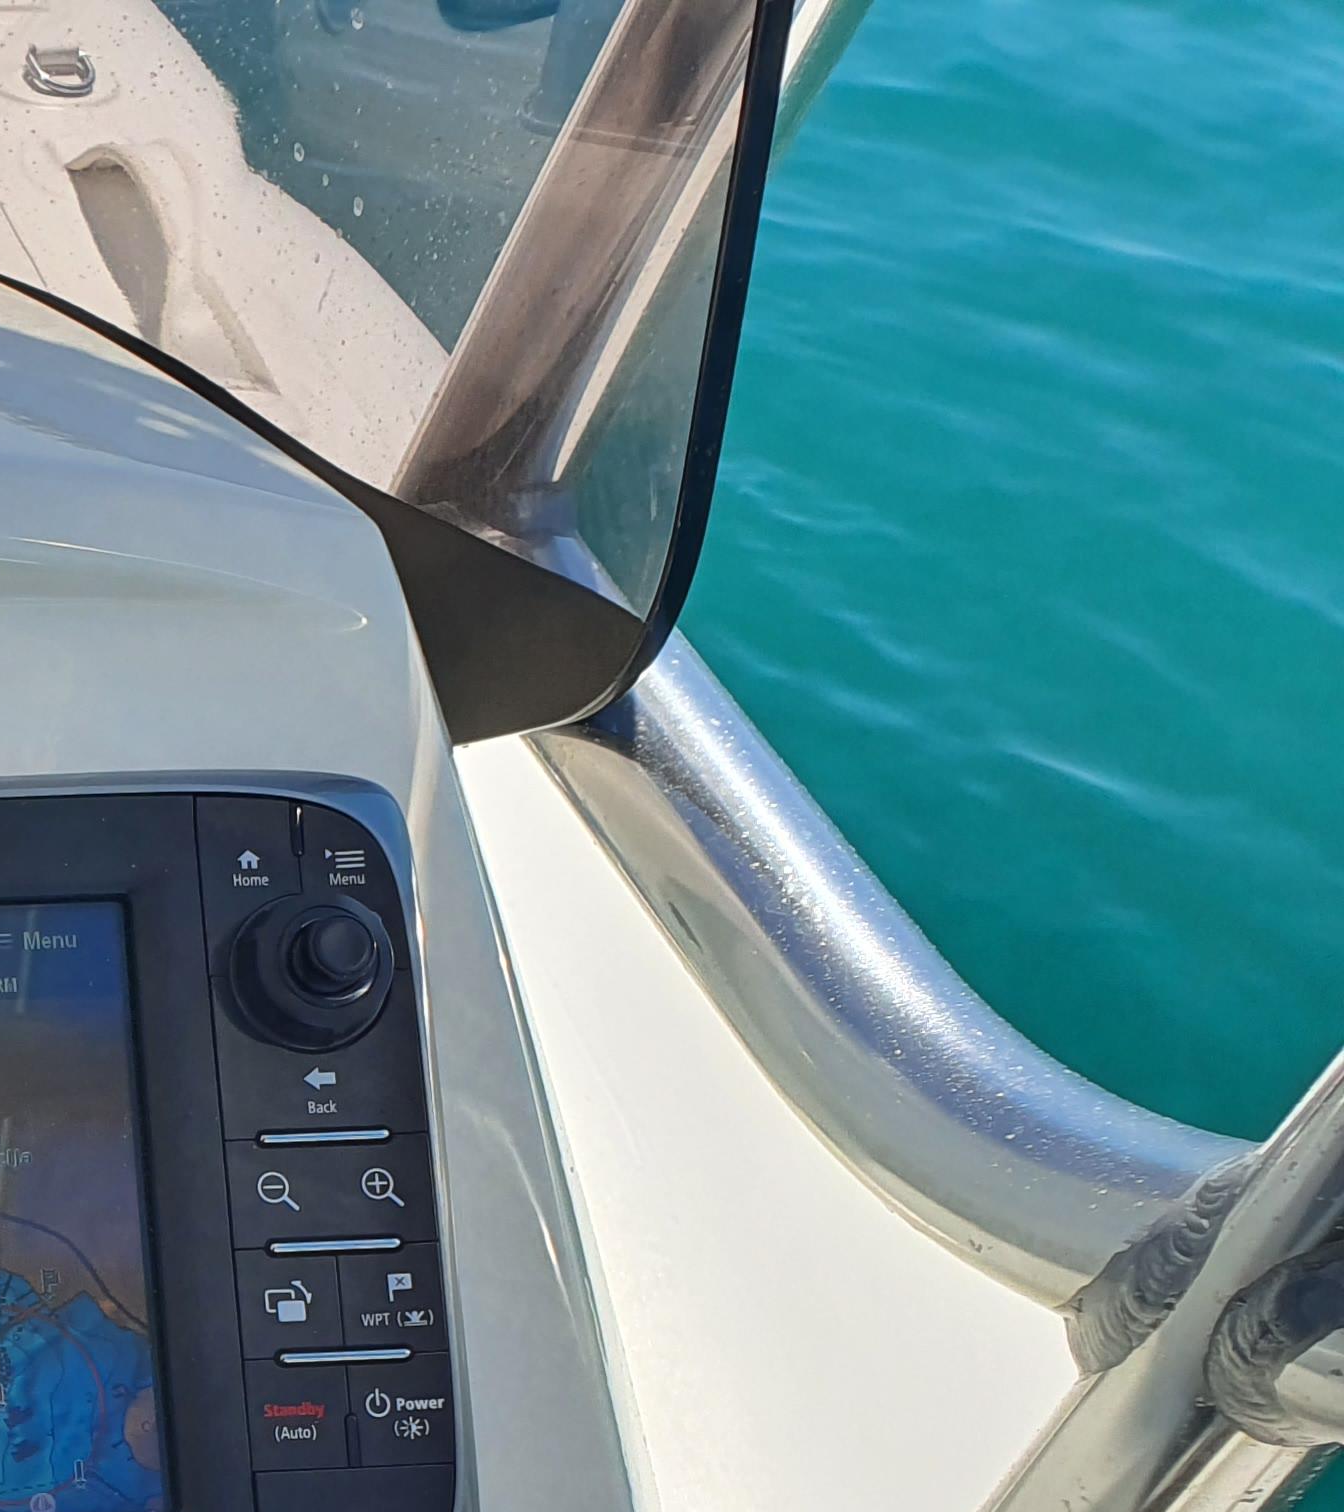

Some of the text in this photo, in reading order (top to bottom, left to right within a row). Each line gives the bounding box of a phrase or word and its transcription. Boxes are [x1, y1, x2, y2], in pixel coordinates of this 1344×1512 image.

[232, 873, 269, 888] Home
[328, 872, 366, 886] Menu
[23, 931, 78, 950] Menu
[307, 1101, 338, 1114] Back
[361, 1313, 390, 1327] WPT
[263, 1403, 326, 1419] Standby
[396, 1396, 445, 1412] Power
[274, 1424, 318, 1441] (Auto)
